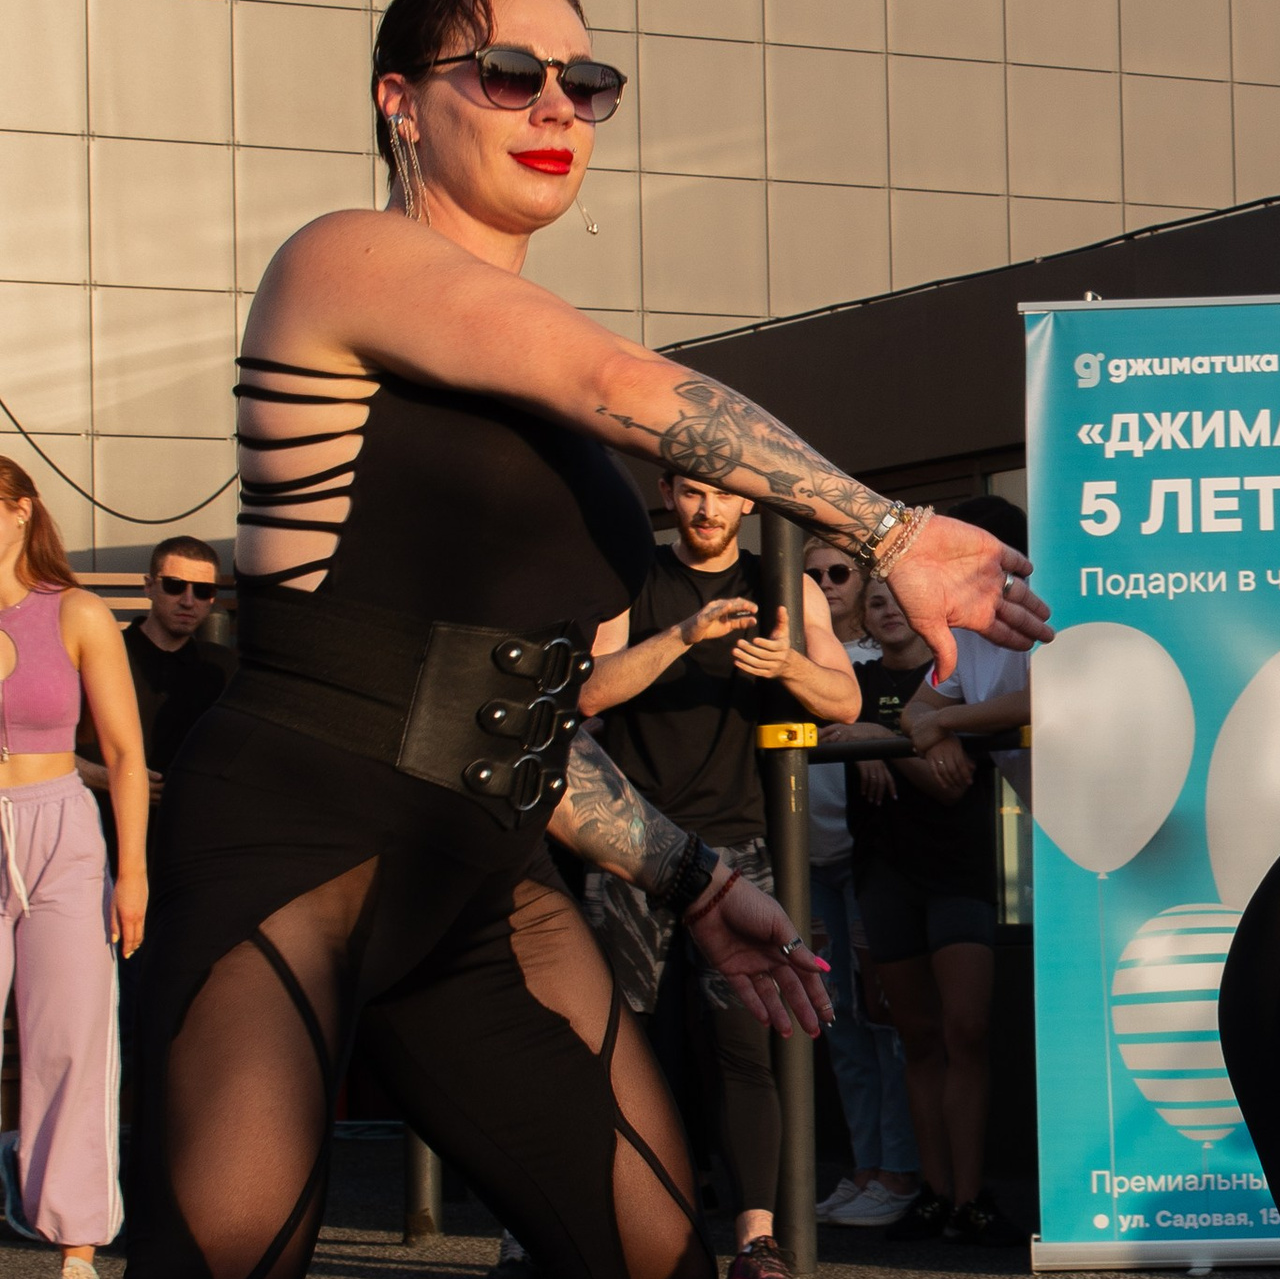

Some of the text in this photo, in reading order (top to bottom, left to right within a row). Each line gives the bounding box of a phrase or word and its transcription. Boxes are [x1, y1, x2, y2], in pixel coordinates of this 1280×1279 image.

[1079, 480, 1122, 537] 5
[1079, 566, 1228, 600] Подарки
[1237, 569, 1257, 592] в
[1118, 1214, 1150, 1233] ул.
[1155, 1209, 1255, 1230] Садовая,
